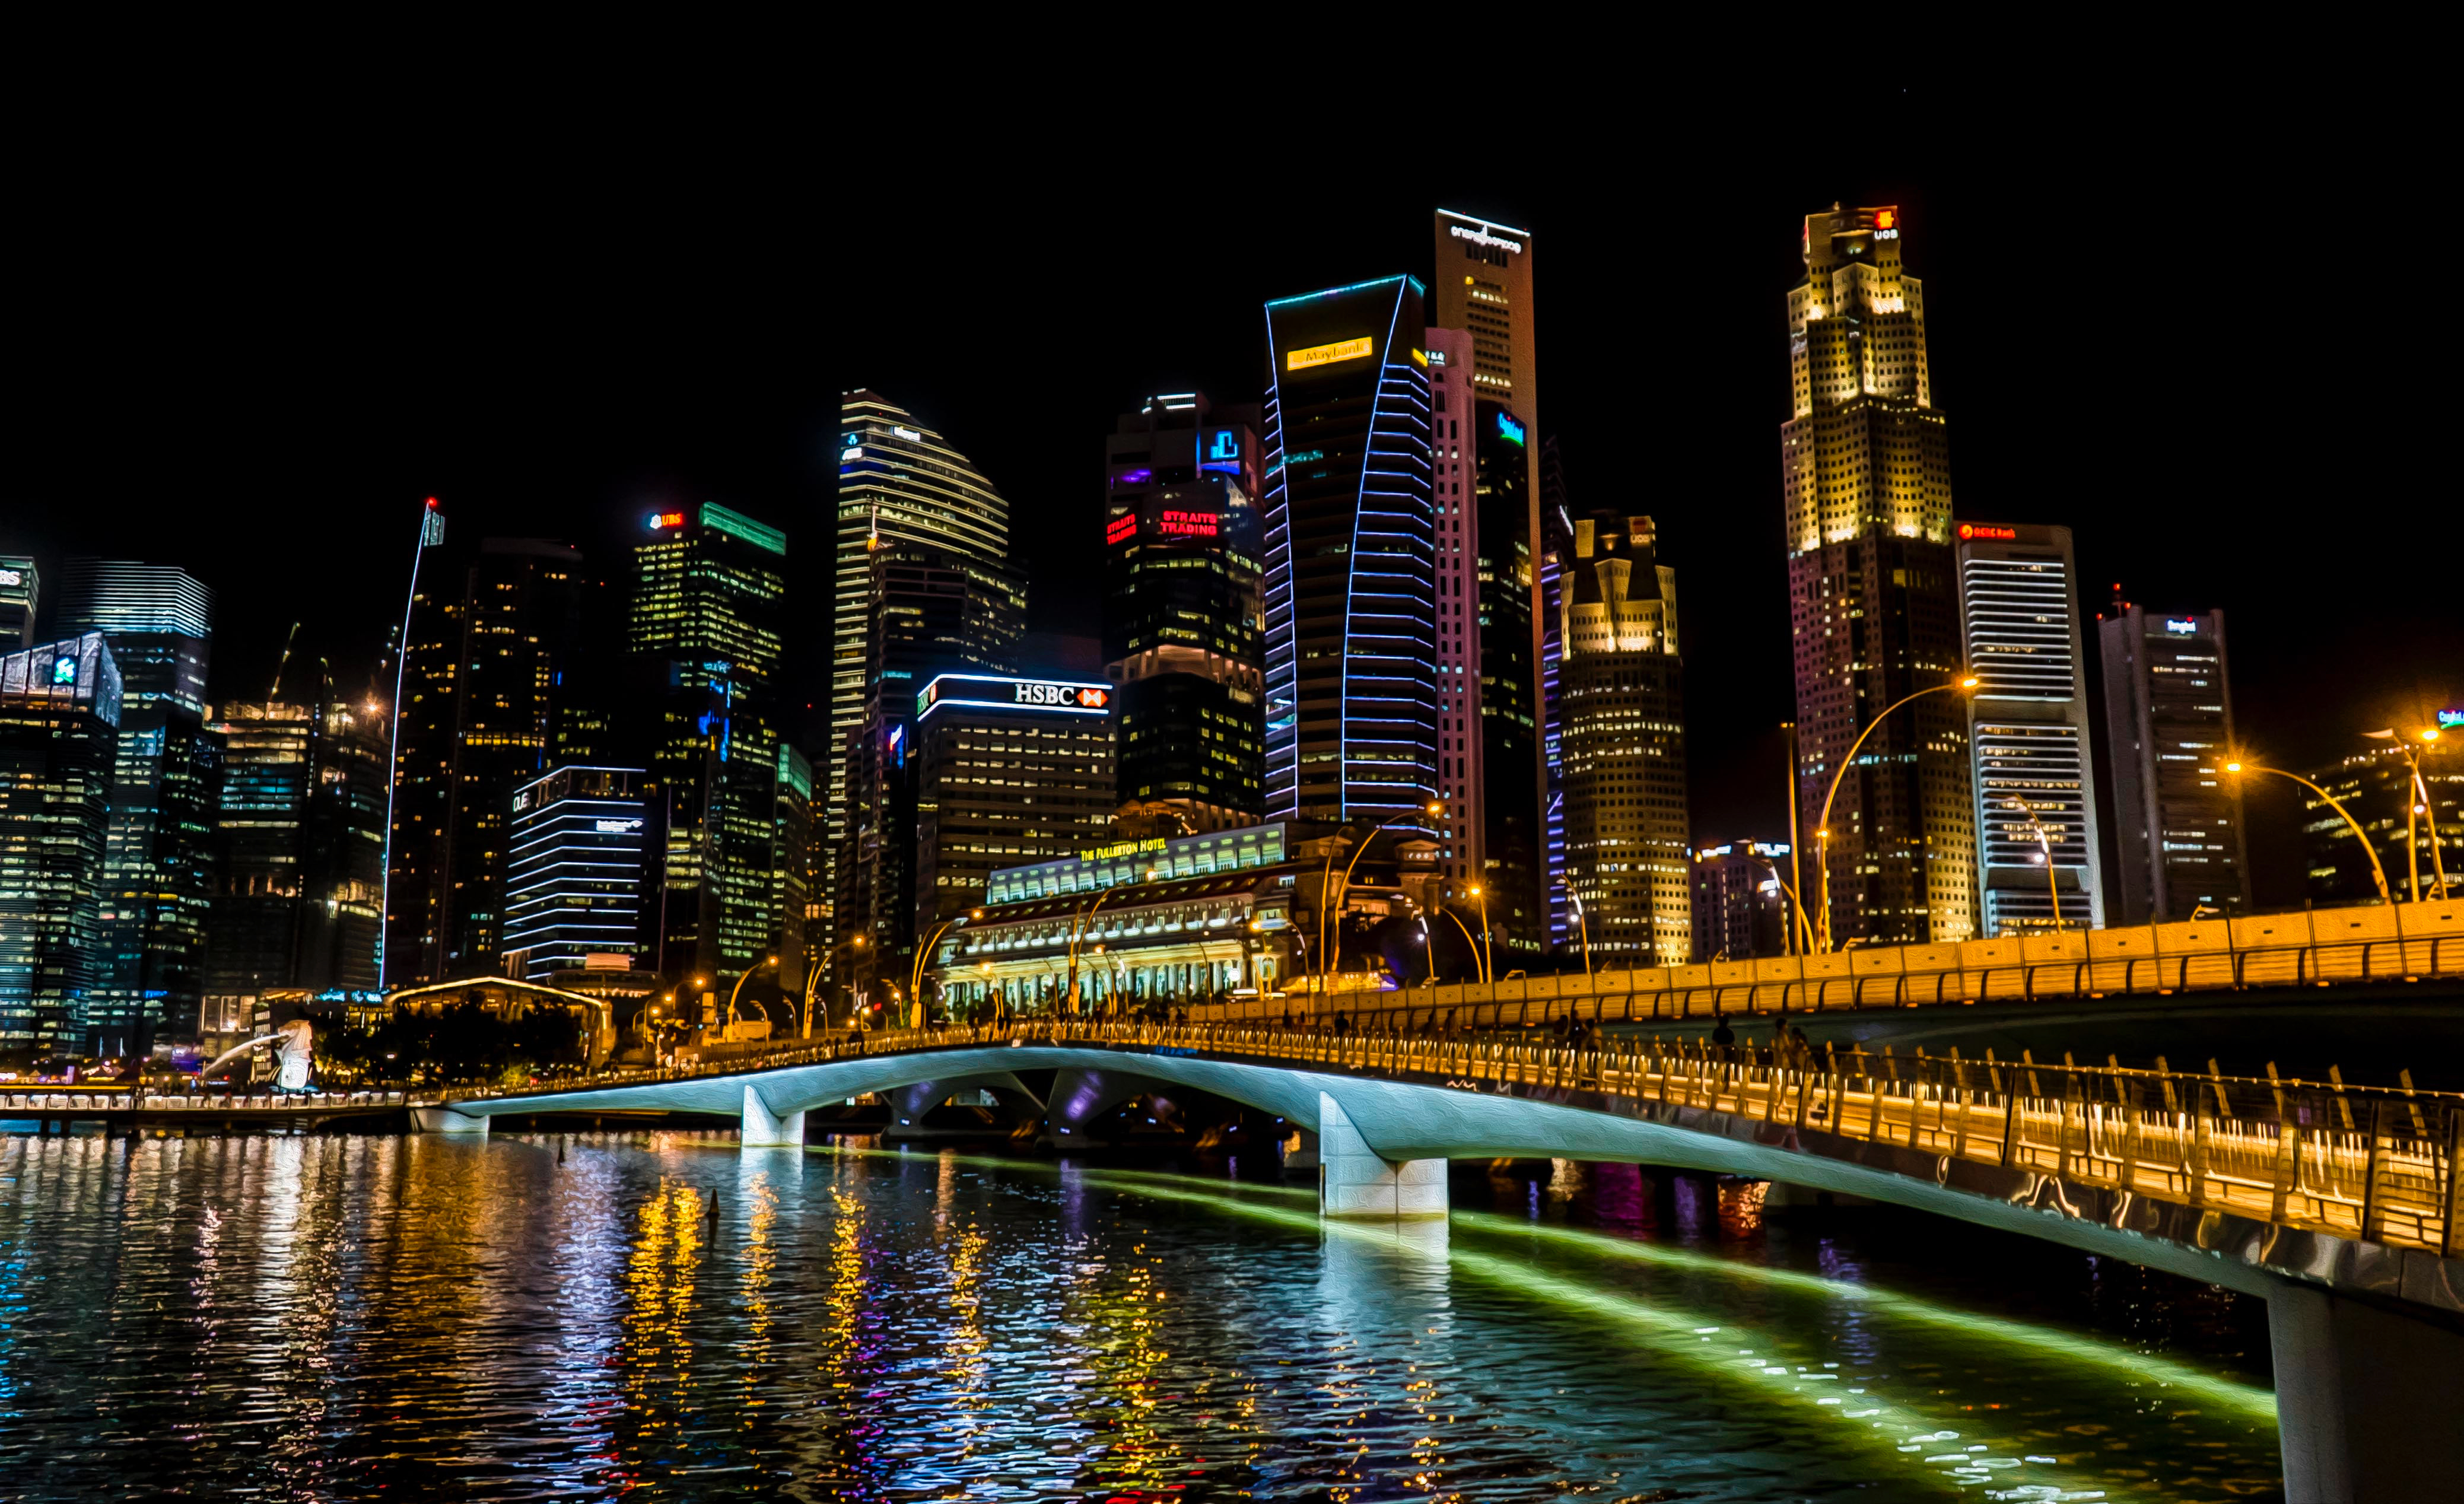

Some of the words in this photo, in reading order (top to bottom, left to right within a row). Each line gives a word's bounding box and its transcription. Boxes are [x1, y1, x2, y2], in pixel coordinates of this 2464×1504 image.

[1874, 229, 1898, 240] UOB
[1306, 341, 1363, 361] Maybank
[662, 513, 681, 526] UBS
[1163, 511, 1216, 523] STRAITS
[1161, 522, 1216, 535] TRADING
[1015, 683, 1074, 705] HSBC
[1080, 850, 1095, 861] THE
[1096, 842, 1138, 859] FULLERTON
[1140, 838, 1166, 852] HOTEL
